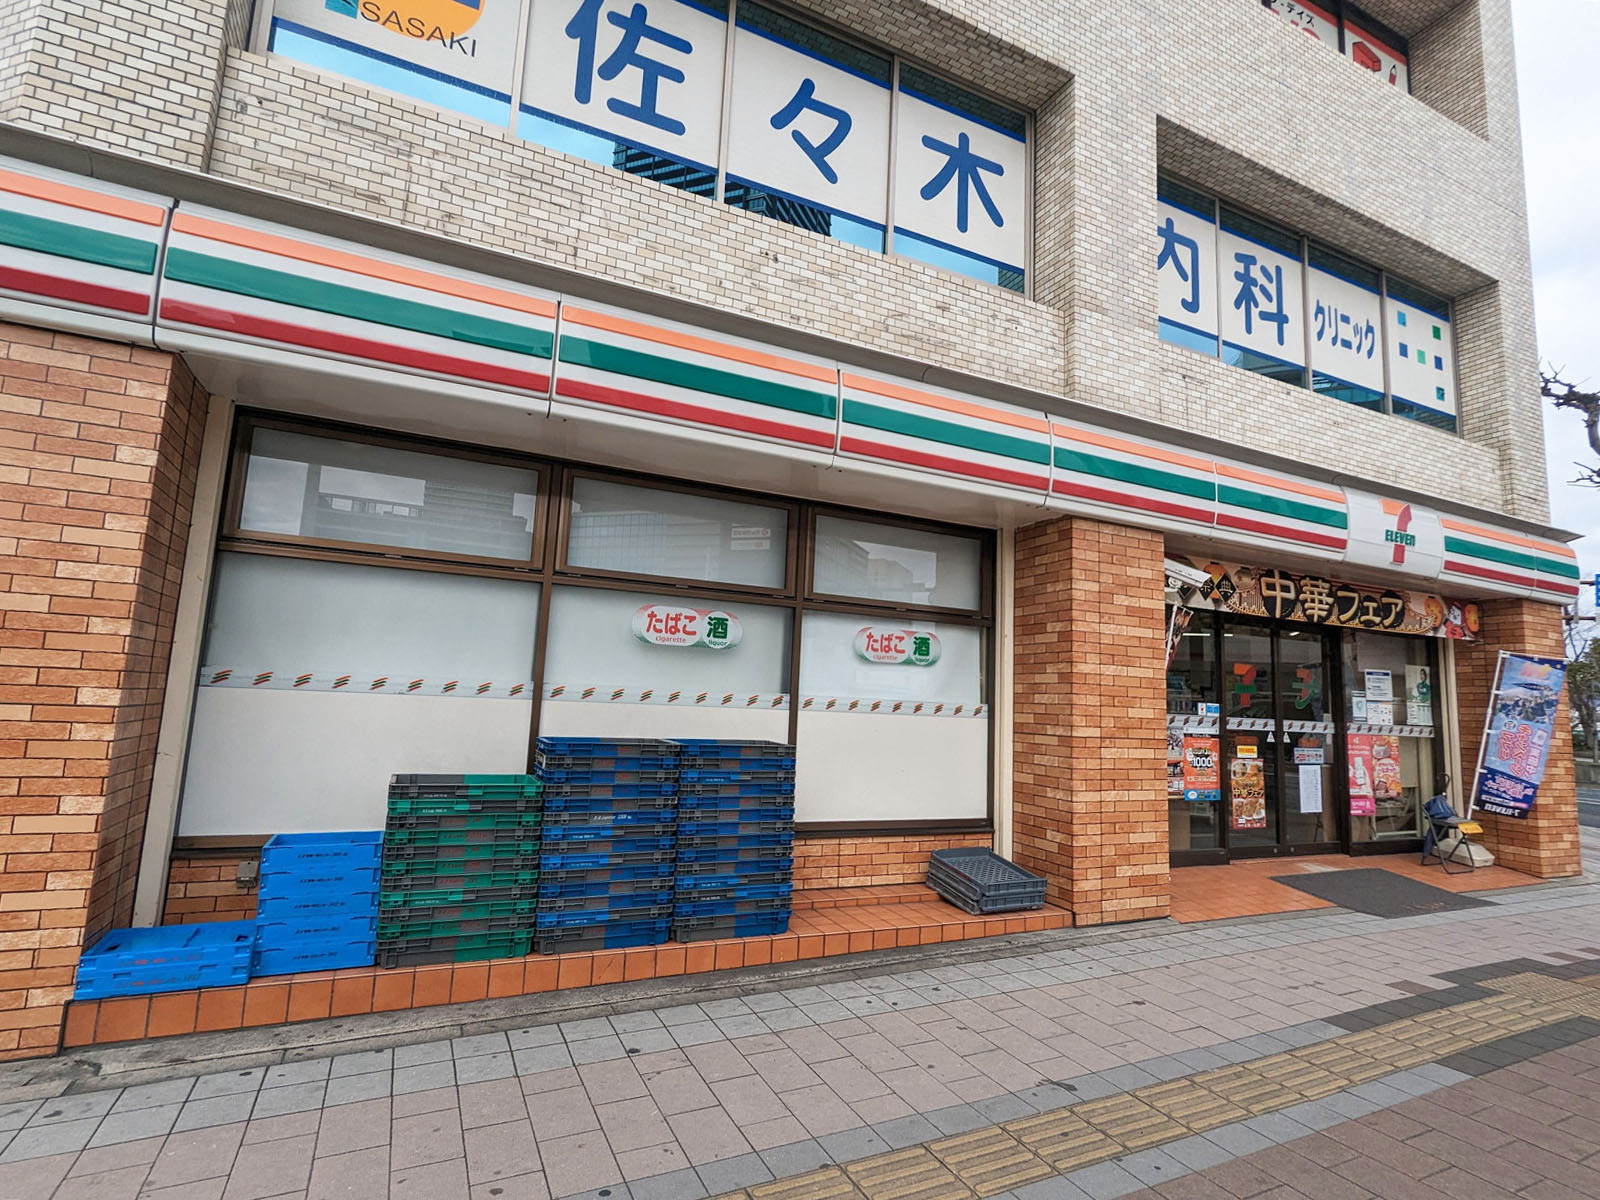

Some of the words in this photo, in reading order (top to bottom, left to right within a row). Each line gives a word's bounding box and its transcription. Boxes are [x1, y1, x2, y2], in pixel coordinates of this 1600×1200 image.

[360, 1, 476, 57] SASAKI
[565, 0, 1004, 233] 佐々木
[1157, 217, 1289, 346] 内科
[1314, 299, 1375, 359] クリニック
[645, 611, 697, 636] たばこ
[706, 616, 729, 639] 酒
[1260, 569, 1403, 628] 中華フェア
[865, 631, 906, 654] たばこ
[913, 636, 931, 657] 酒
